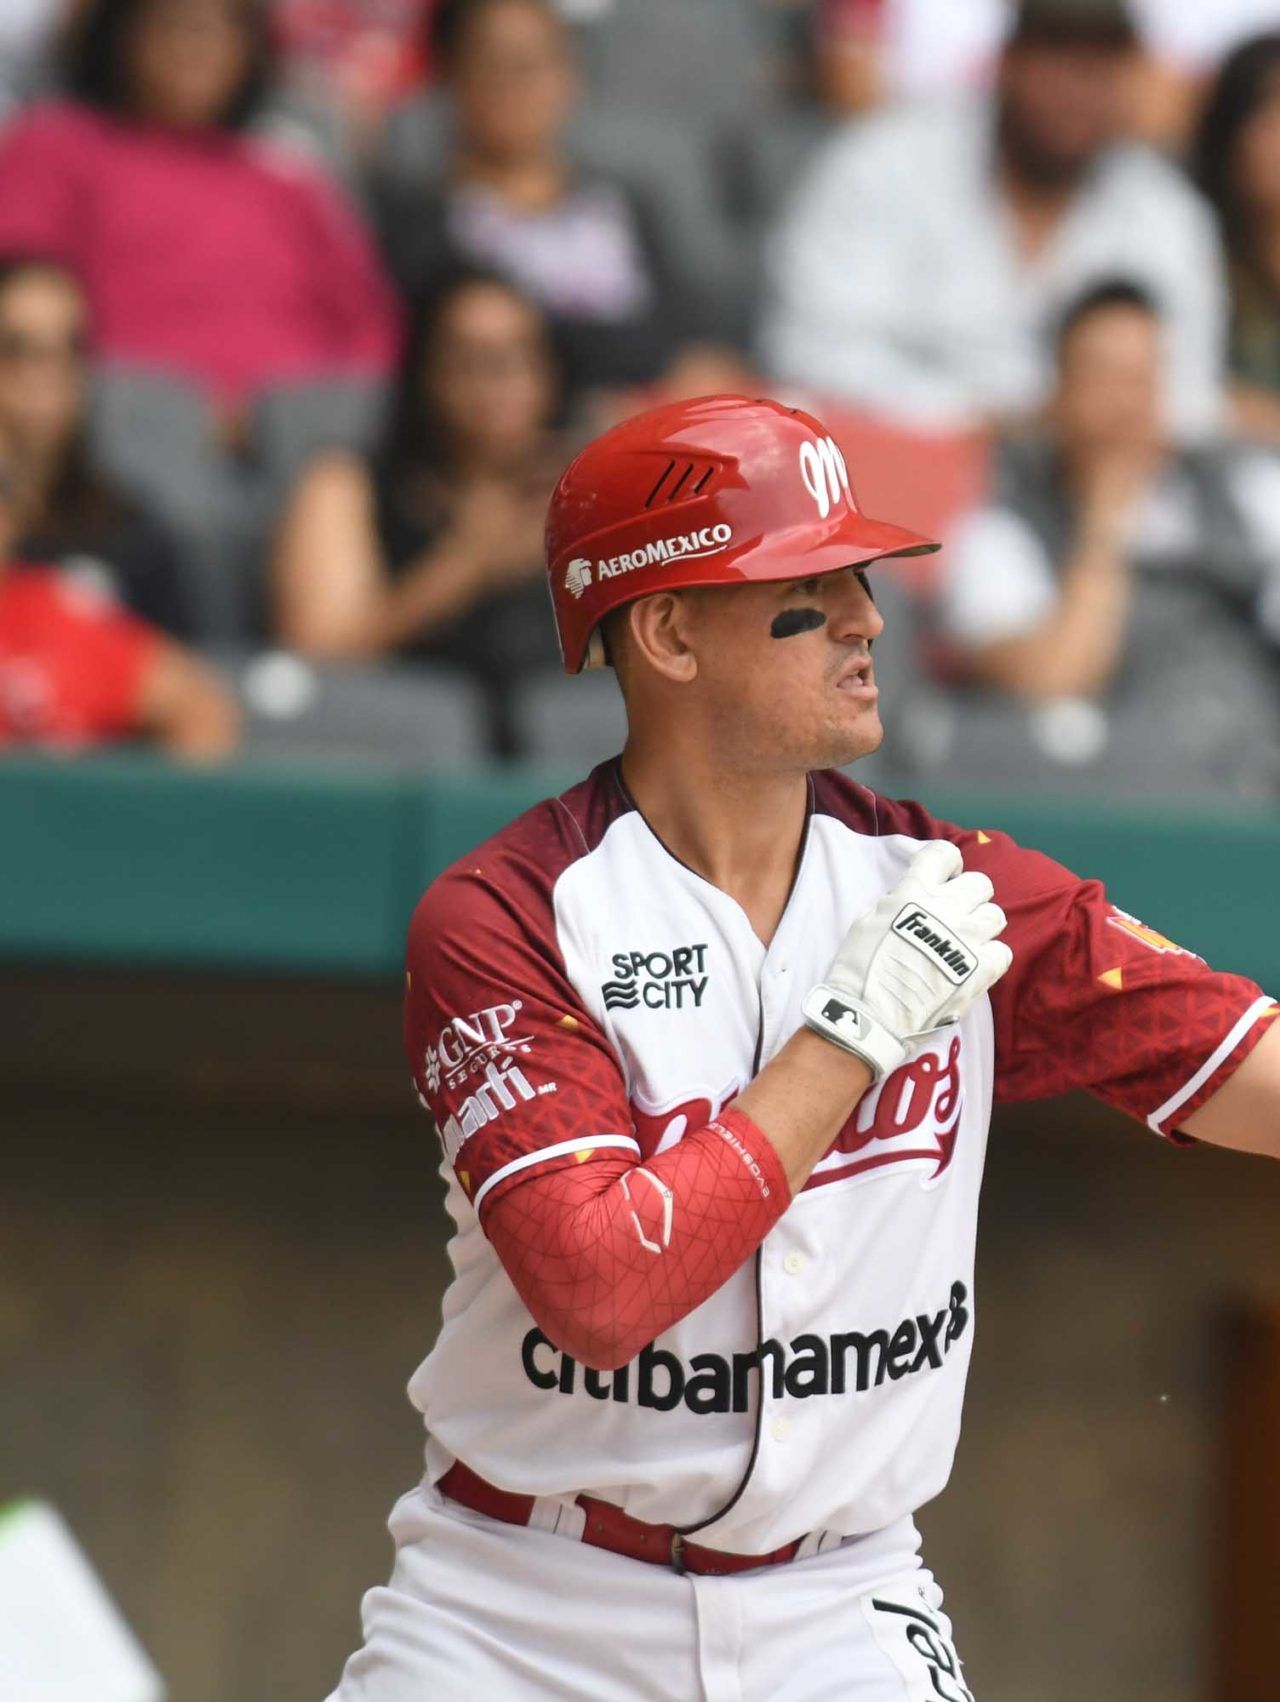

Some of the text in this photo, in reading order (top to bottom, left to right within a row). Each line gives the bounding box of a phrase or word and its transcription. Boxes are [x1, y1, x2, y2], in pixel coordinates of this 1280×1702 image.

[611, 944, 708, 979] SPORT
[895, 911, 971, 977] Franklin
[643, 976, 709, 1009] CITY
[438, 1003, 516, 1069] GNP
